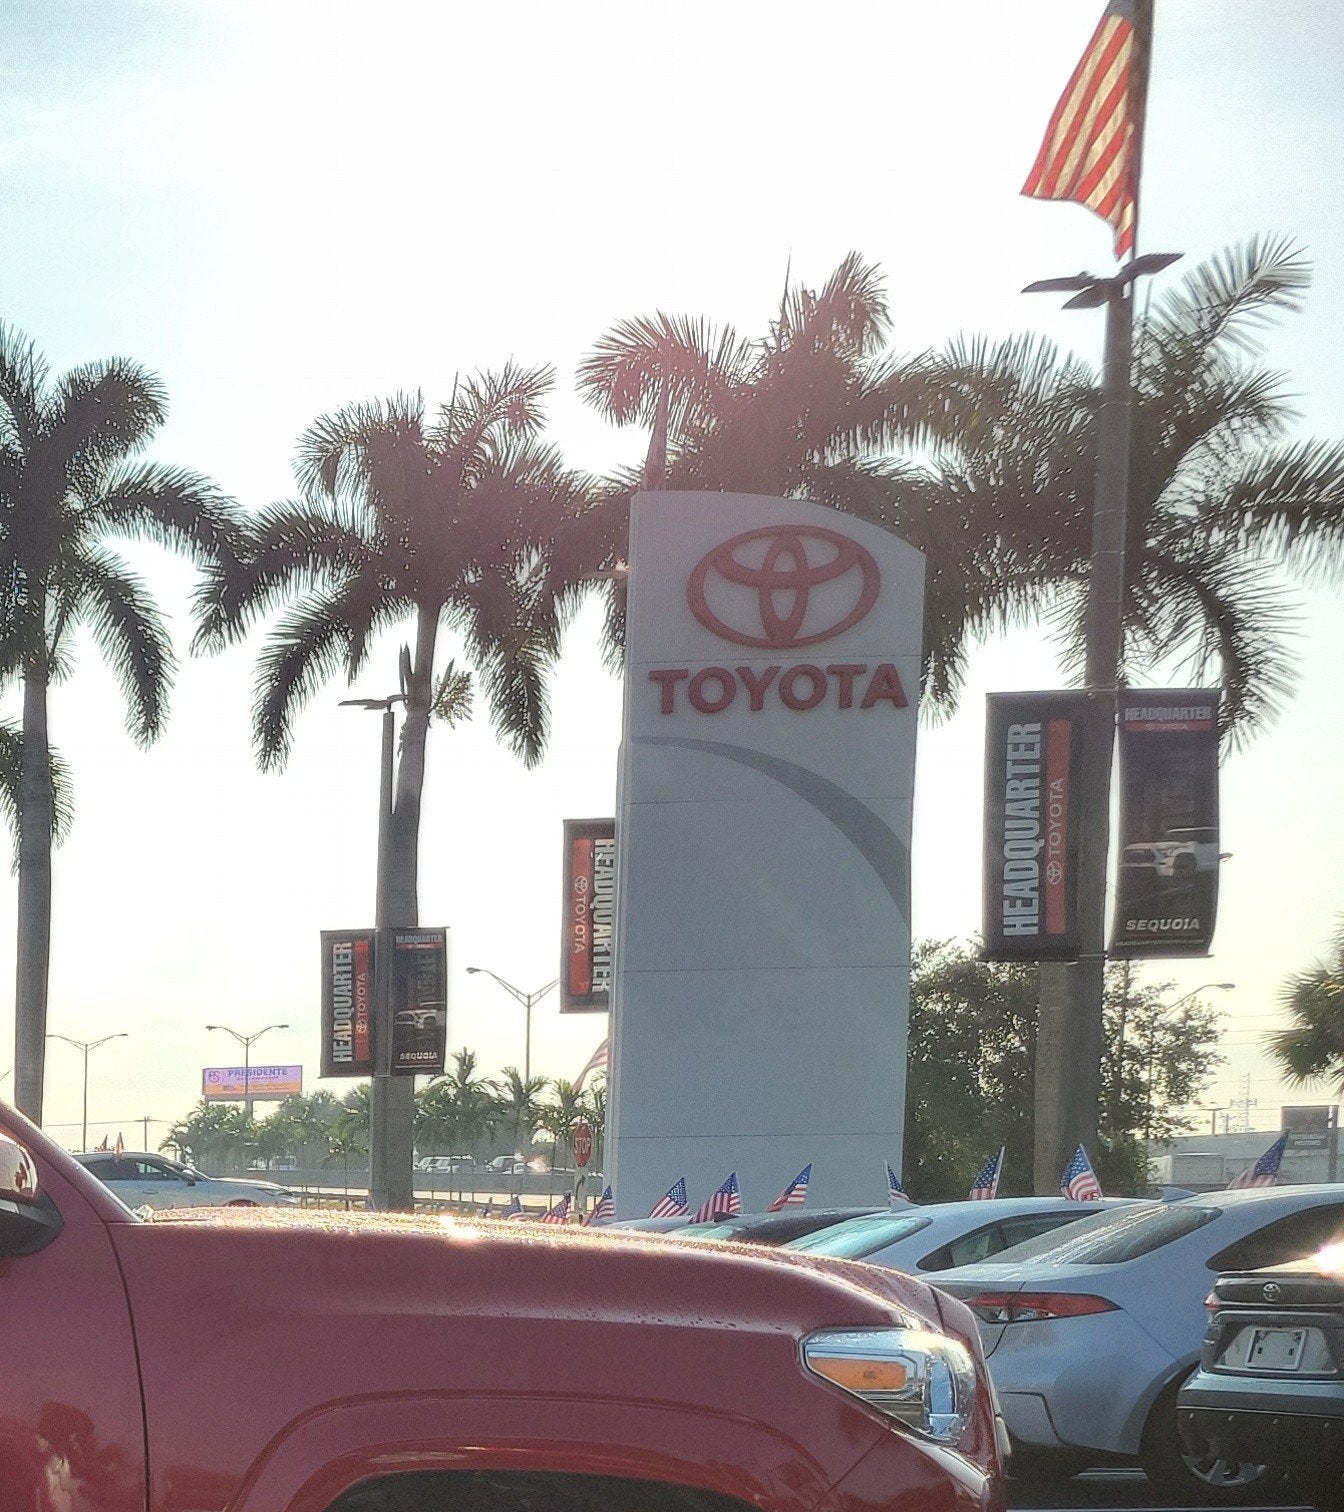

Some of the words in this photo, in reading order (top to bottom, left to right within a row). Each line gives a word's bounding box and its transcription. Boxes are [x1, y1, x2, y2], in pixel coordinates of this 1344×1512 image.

[648, 663, 909, 715] TOYOTA
[1003, 722, 1045, 937] HEADQUARTER
[1048, 777, 1064, 859] TOYOTA
[574, 896, 587, 954] TOYOTA
[1125, 918, 1201, 932] SEQUOIA
[332, 941, 354, 1062] HEADQUARTER
[356, 972, 367, 1018] TOYOTA
[399, 1051, 438, 1060] SEQUOIA
[574, 1136, 591, 1154] STOP
